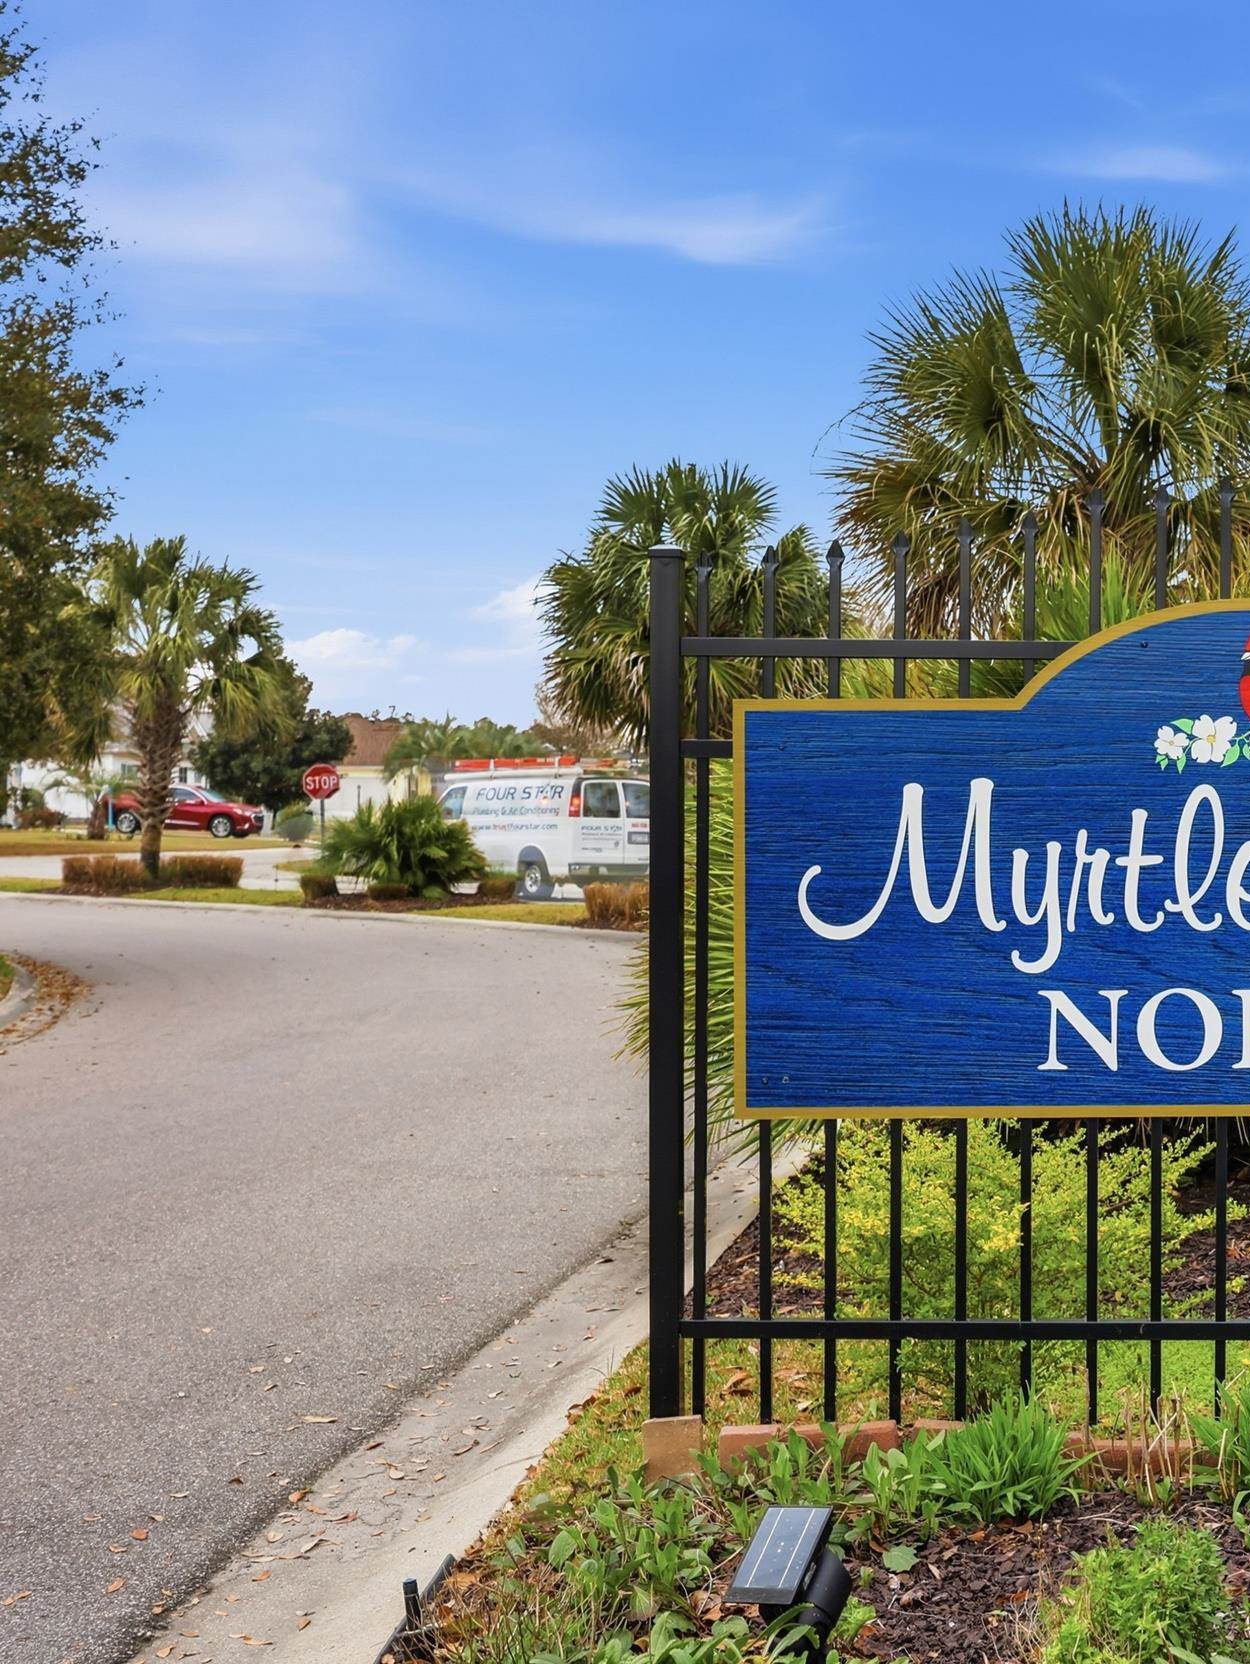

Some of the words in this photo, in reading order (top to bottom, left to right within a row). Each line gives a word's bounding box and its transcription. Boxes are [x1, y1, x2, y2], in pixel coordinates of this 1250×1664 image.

[306, 776, 337, 790] STOP
[476, 786, 517, 801] FOUR
[521, 784, 565, 800] STAR
